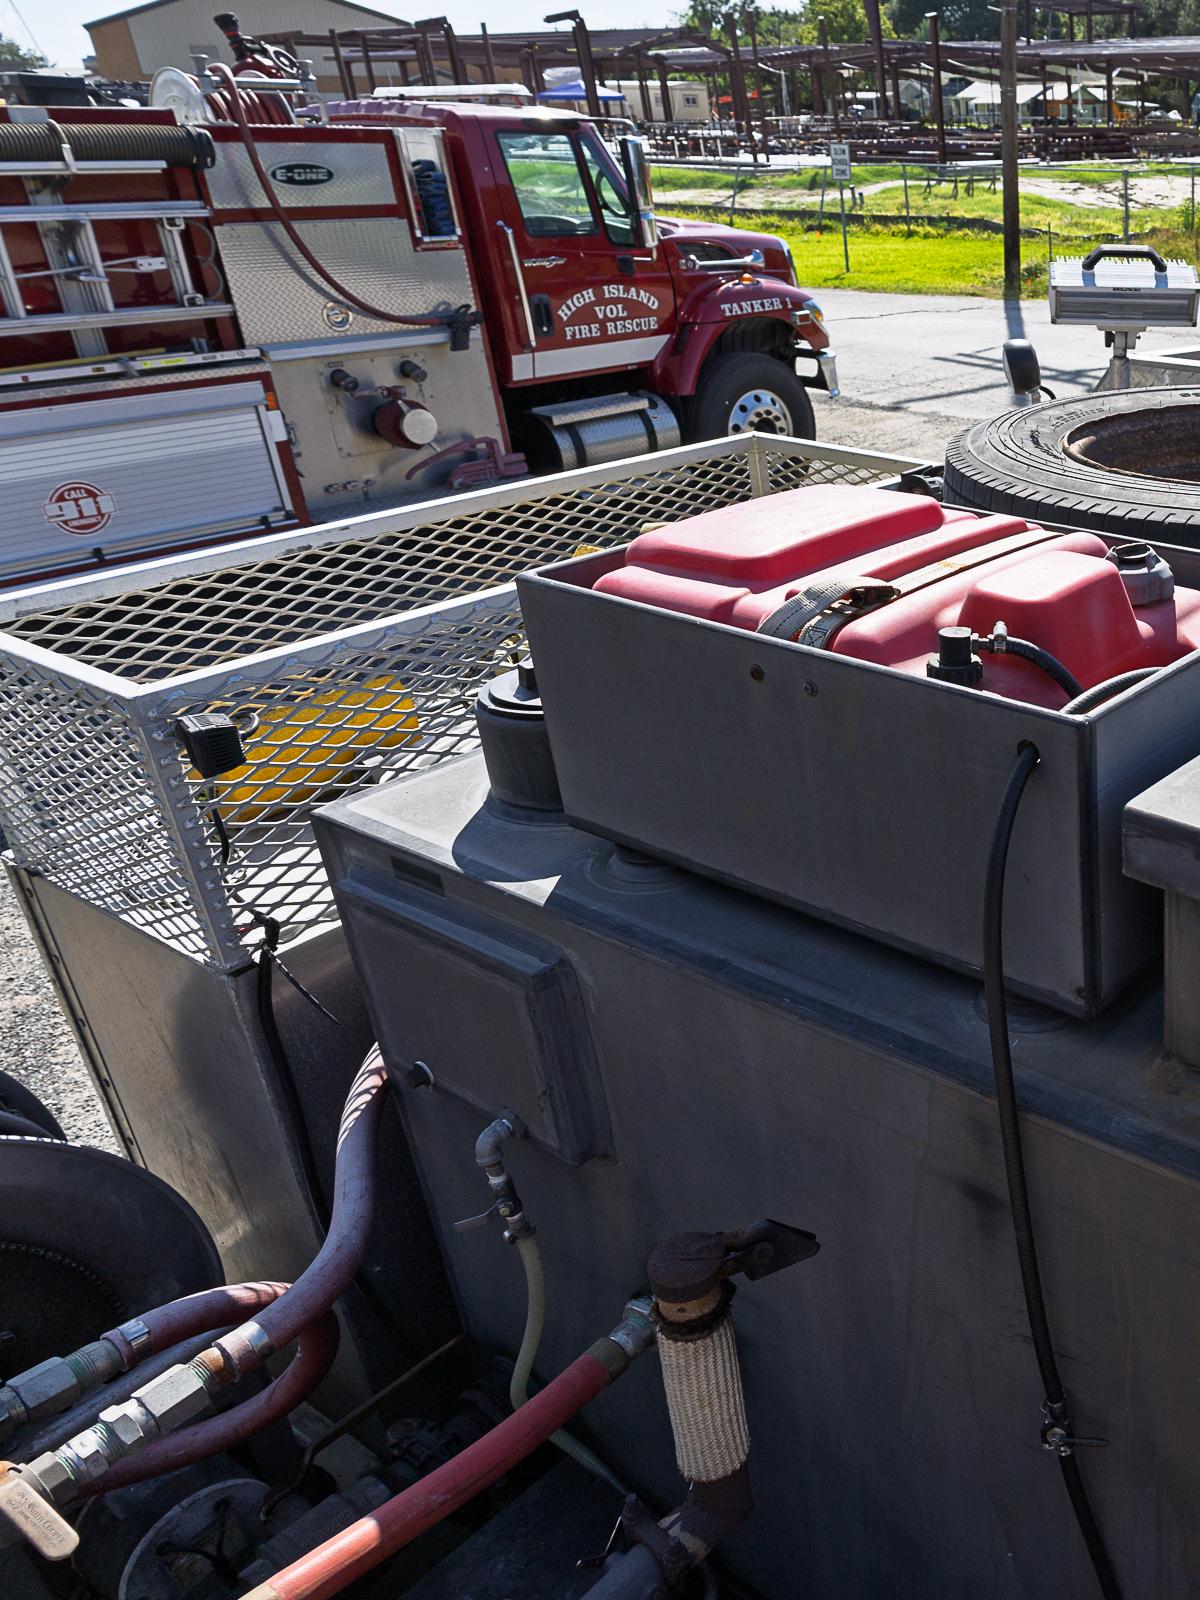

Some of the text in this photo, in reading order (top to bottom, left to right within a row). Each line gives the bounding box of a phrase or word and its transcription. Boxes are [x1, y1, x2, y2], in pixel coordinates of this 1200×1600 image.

[275, 168, 329, 180] E-ONE
[557, 284, 660, 321] HIGH ISLAND
[594, 304, 628, 319] VOL
[720, 297, 793, 316] TANKER 1
[564, 316, 659, 340] FIRE RESCUE
[64, 489, 88, 500] CALL
[43, 494, 118, 523] 911
